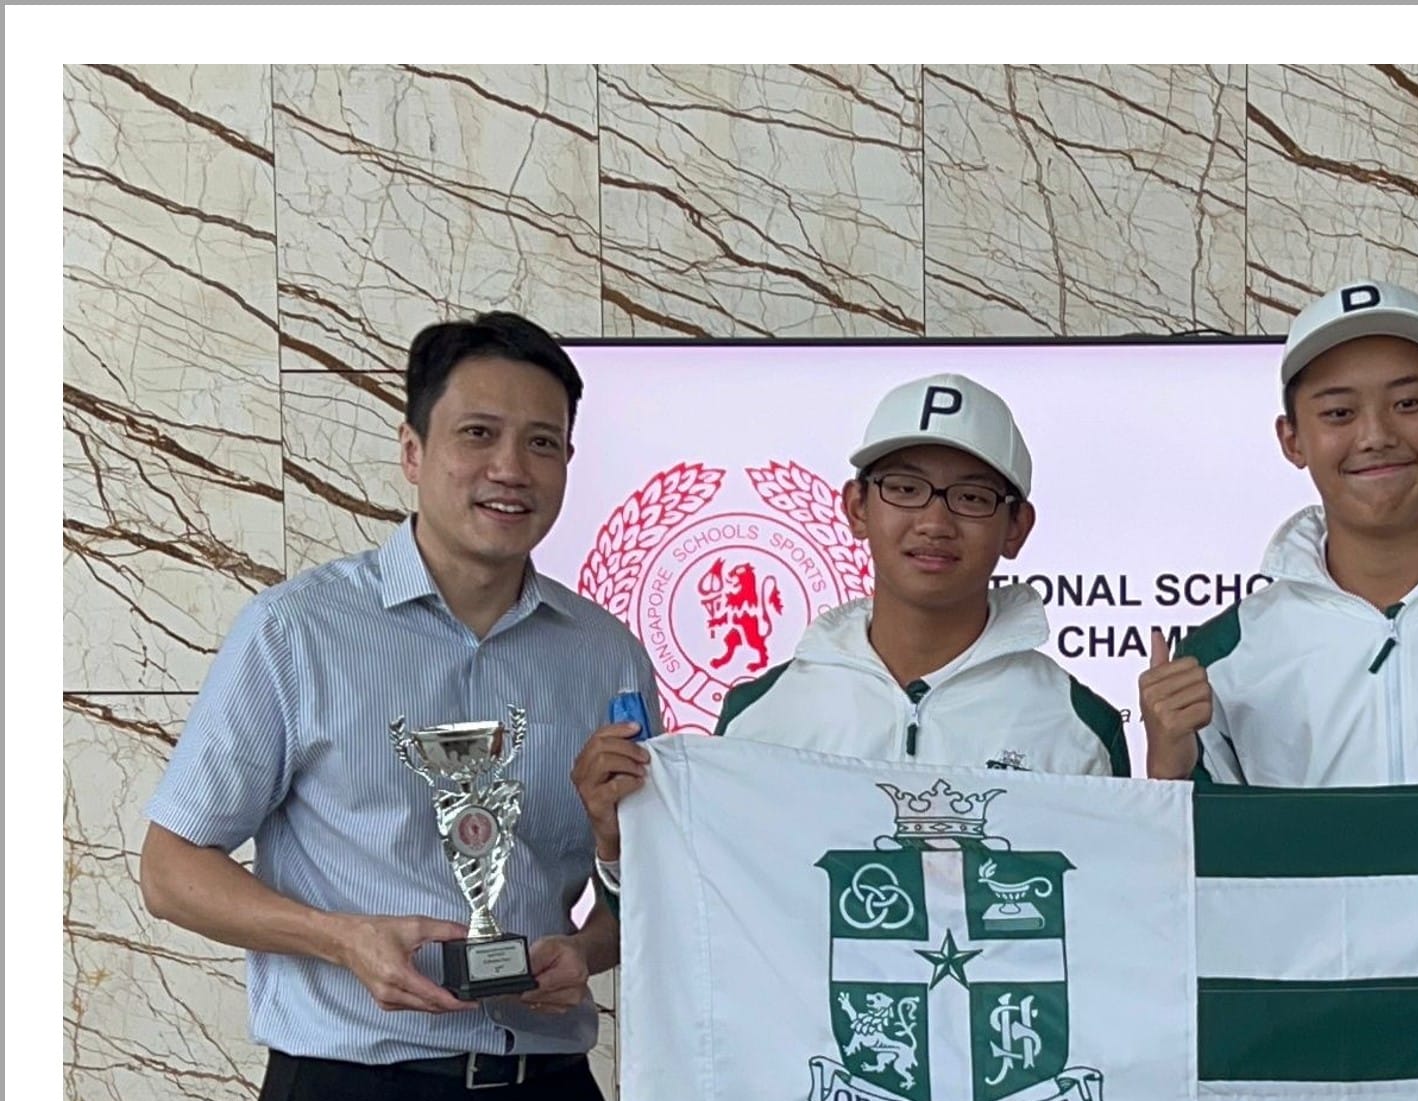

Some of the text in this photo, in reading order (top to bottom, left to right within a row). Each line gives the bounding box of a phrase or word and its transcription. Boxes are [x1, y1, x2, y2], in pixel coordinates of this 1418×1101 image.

[918, 385, 964, 432] P
[647, 523, 827, 674] SINGAPORE SCHOOLS SPORTS
